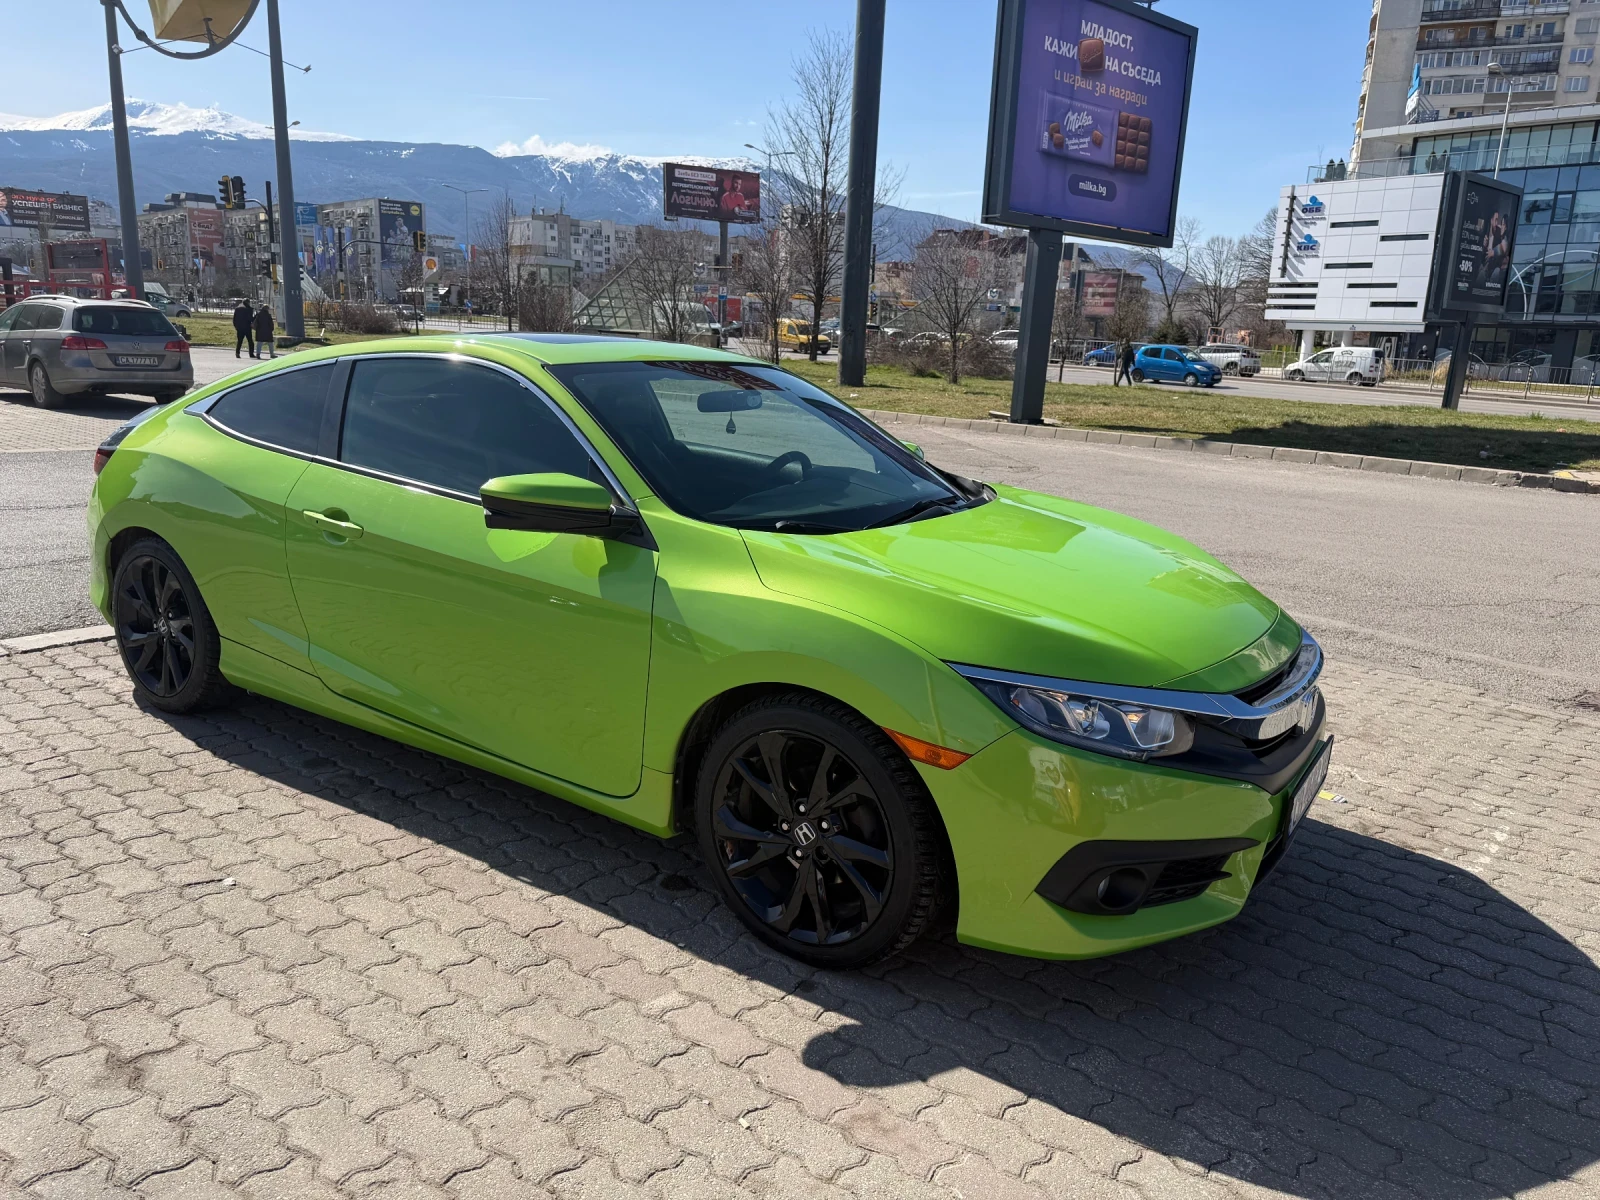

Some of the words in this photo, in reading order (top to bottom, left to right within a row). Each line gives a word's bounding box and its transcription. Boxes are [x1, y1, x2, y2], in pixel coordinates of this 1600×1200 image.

[1081, 20, 1134, 52] МЛАДОСТ,
[1044, 35, 1078, 60] КАЖИ
[1105, 56, 1119, 73] НА
[1121, 61, 1161, 87] СЪСЕДА
[1054, 69, 1061, 80] и
[1063, 74, 1092, 90] играй
[1094, 81, 1106, 96] за
[1109, 85, 1148, 107] награди
[1064, 109, 1093, 132] Milka
[1078, 181, 1107, 196] milka.bg
[11, 200, 51, 209] УСПЕШЕН
[53, 203, 84, 212] БИЗНЕС
[671, 192, 718, 208] Логично.
[1459, 260, 1473, 273] -50%
